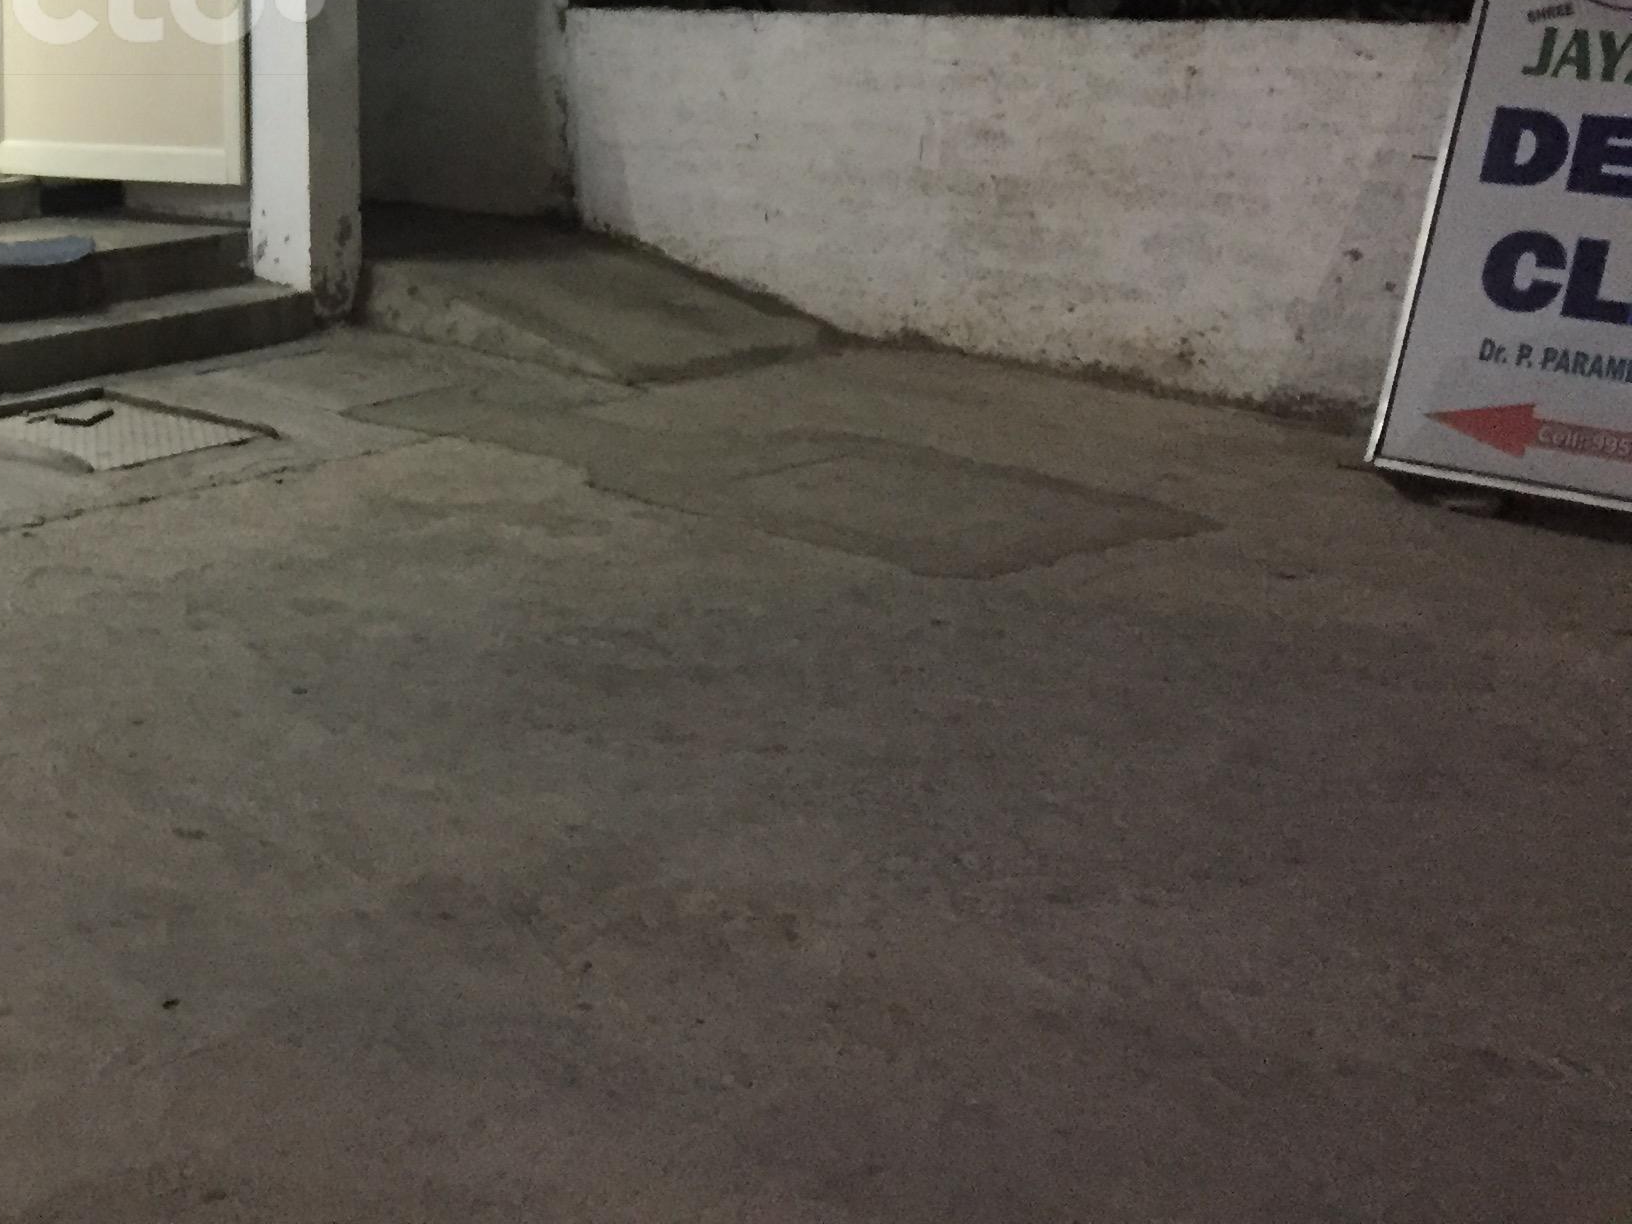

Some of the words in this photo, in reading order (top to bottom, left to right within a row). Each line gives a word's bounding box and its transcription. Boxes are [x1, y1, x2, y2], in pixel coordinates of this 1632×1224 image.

[1521, 26, 1632, 85] JAY
[1479, 337, 1506, 364] Dr.
[1515, 343, 1532, 368] P.
